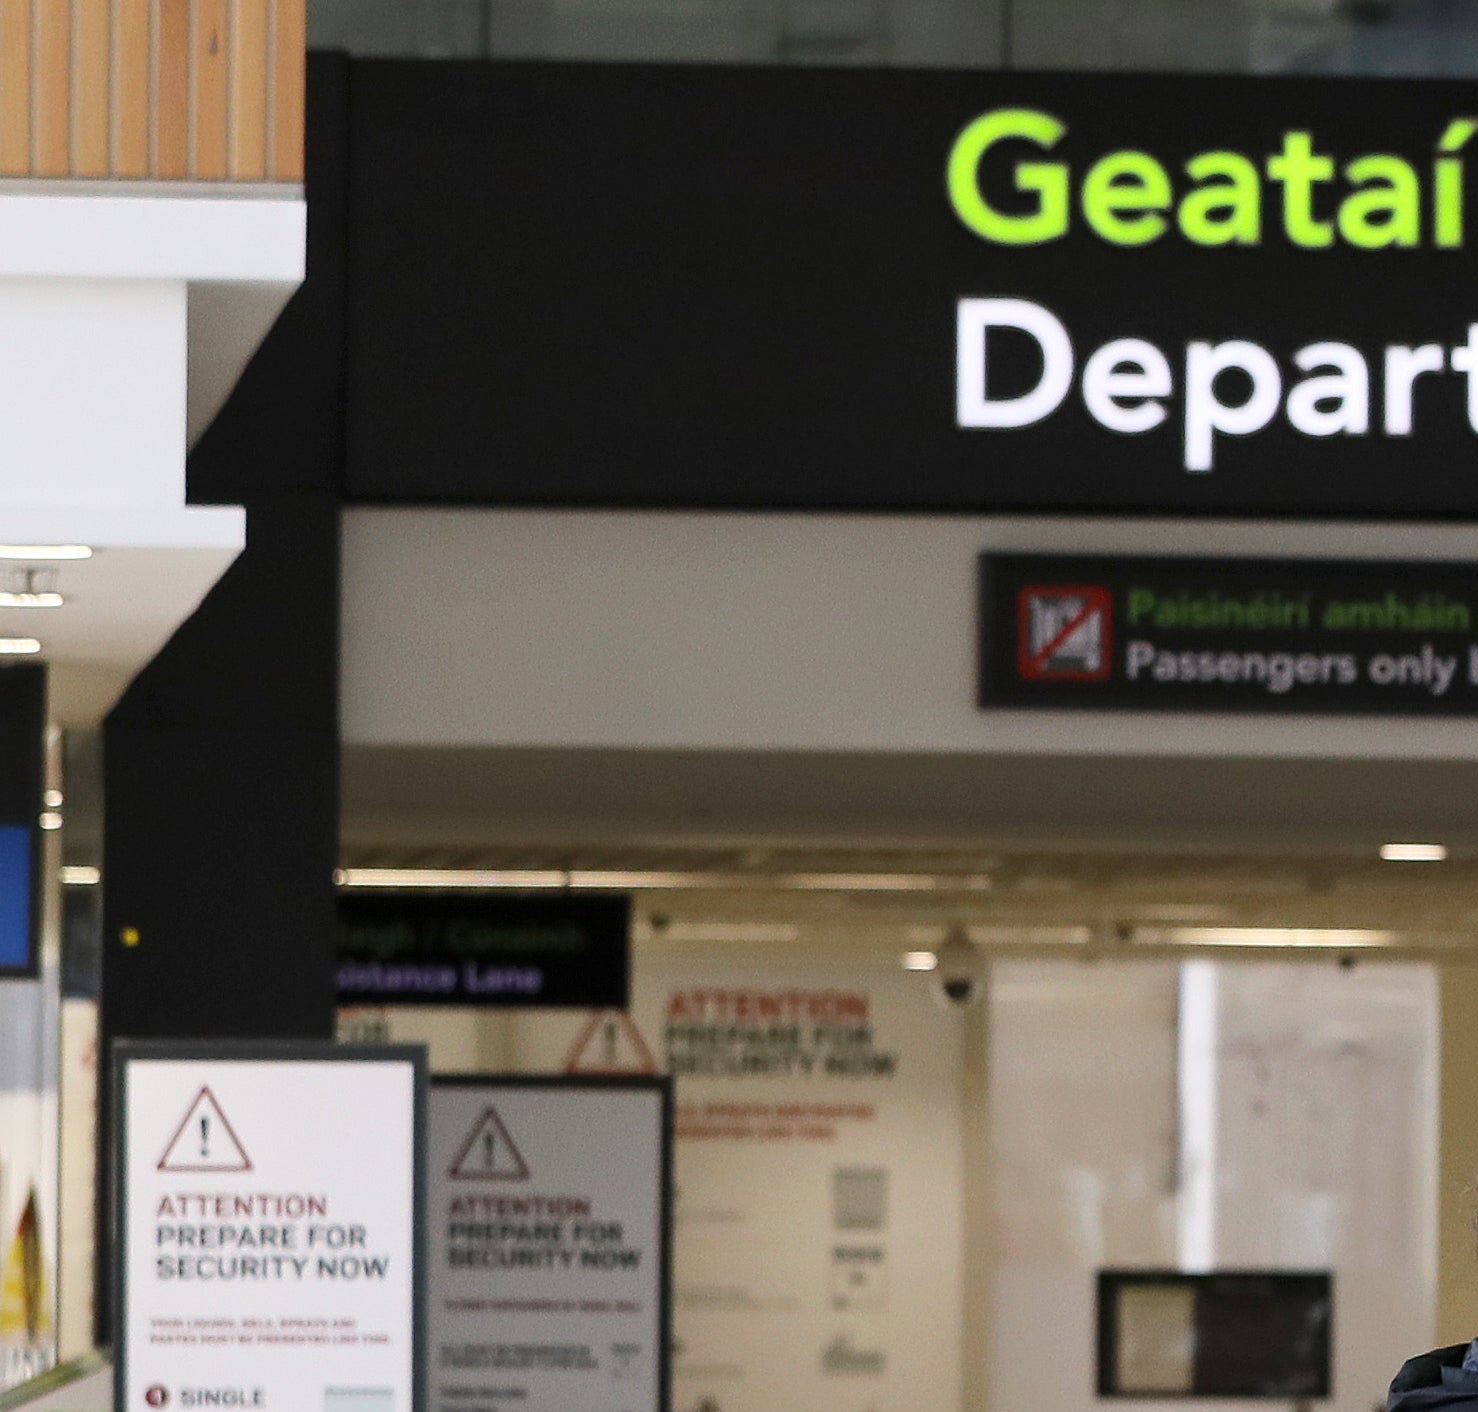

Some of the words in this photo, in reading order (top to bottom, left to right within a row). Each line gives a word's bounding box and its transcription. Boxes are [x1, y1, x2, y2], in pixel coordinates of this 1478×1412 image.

[945, 108, 1478, 249] Geataí
[1126, 640, 1358, 694] Passengers
[1368, 644, 1457, 696] only
[666, 988, 870, 1021] ATTENTION
[156, 1192, 328, 1220] ATTENTION
[447, 1194, 591, 1218] ATTENTION
[155, 1223, 295, 1250] PREPARE
[307, 1223, 368, 1251] FOR
[155, 1253, 308, 1282] SECURITY
[316, 1255, 390, 1281] NOW
[578, 1247, 642, 1270] NOW
[179, 1386, 265, 1409] SINGLE
